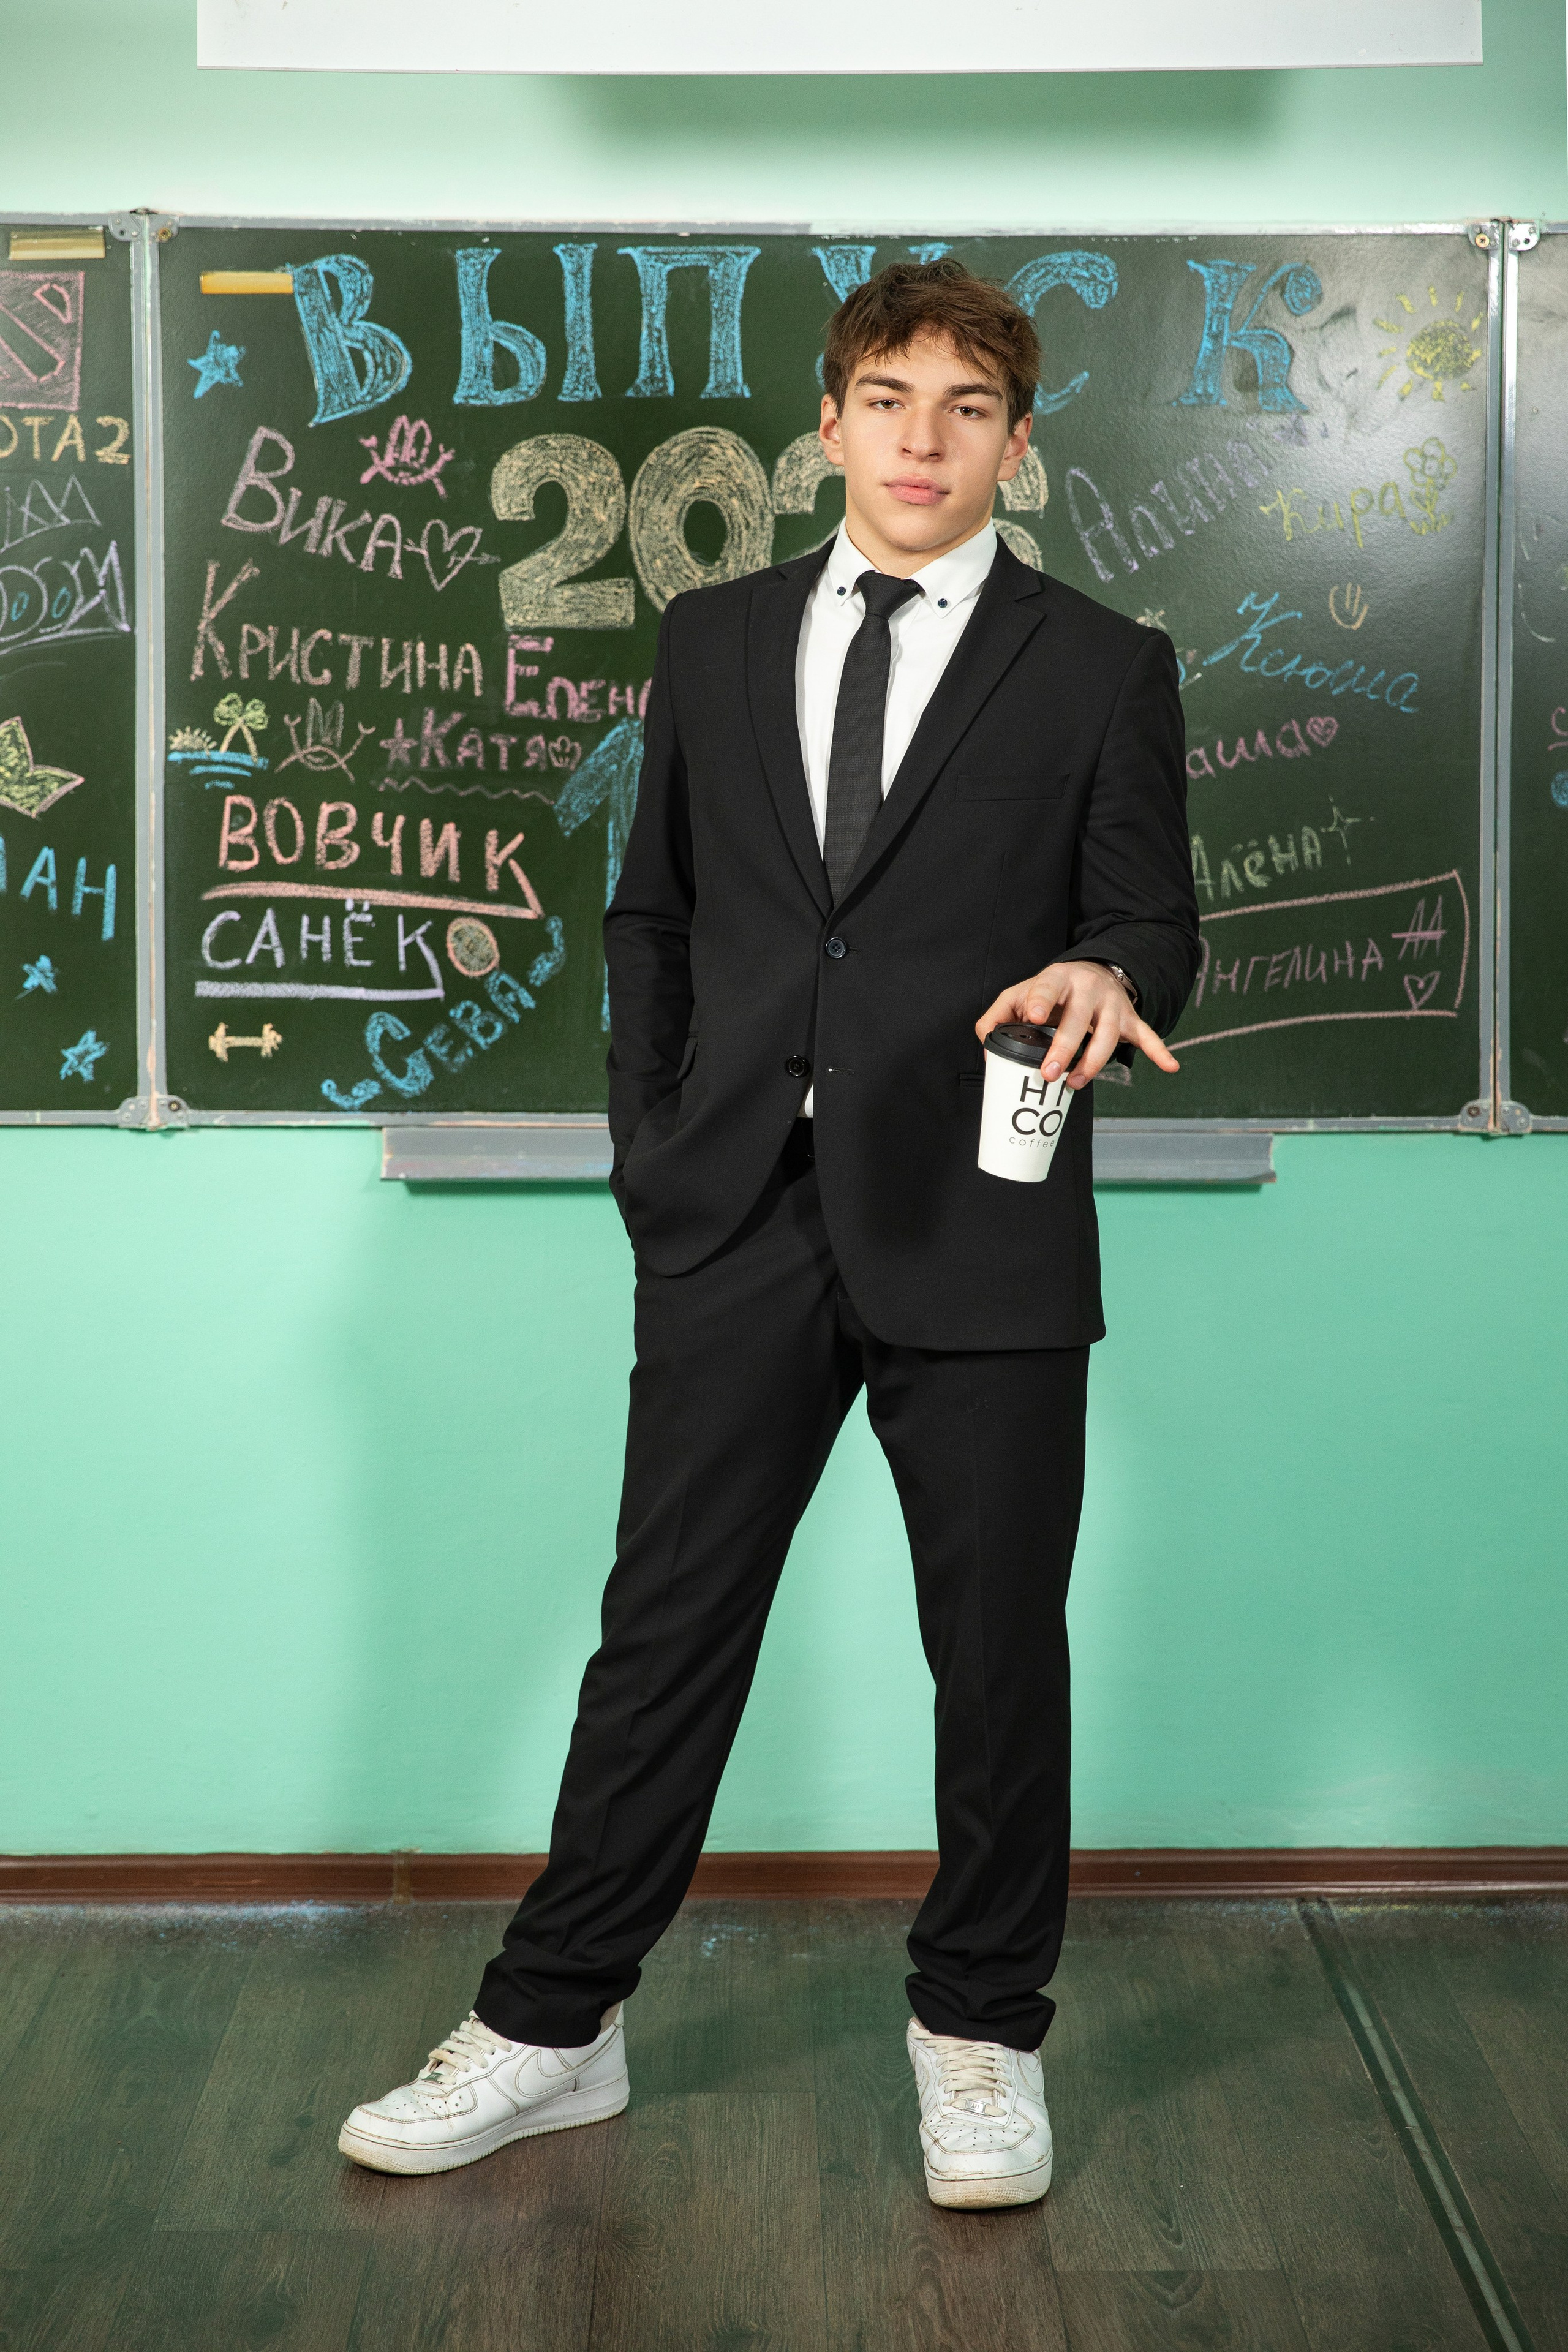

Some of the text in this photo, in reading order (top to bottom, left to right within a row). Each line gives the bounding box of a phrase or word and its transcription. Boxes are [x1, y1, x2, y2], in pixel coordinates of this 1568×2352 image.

[218, 795, 544, 919] ВОВЧИК
[202, 898, 445, 990] САНЁК
[1020, 1075, 1066, 1107] HI
[1012, 1107, 1063, 1137] CO
[1009, 1136, 1055, 1148] coffee
